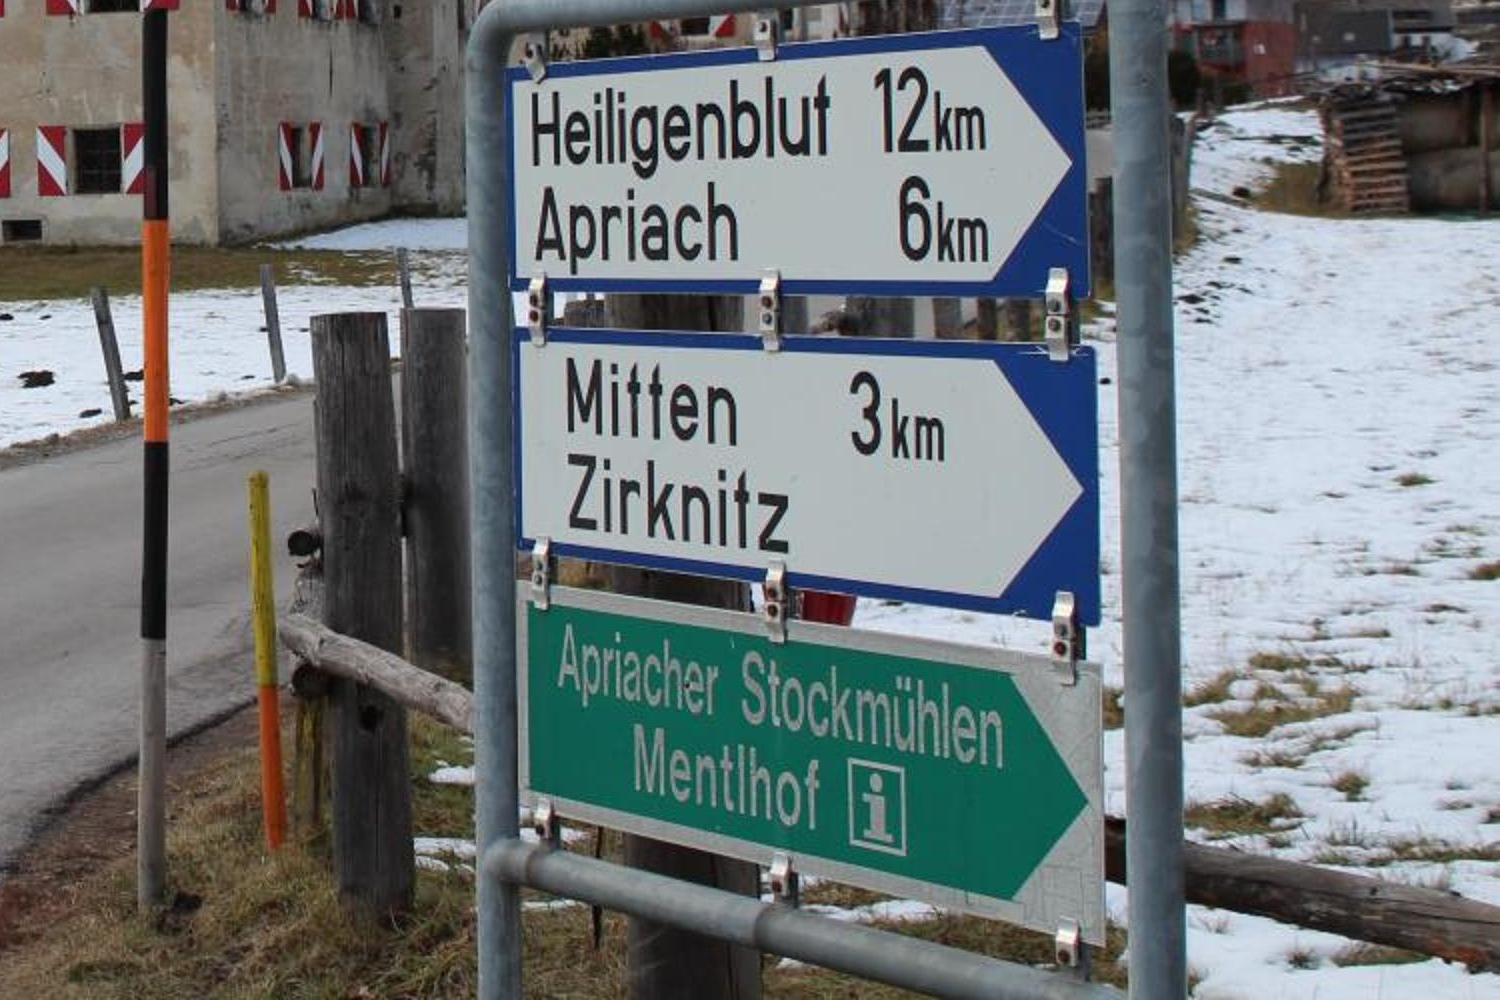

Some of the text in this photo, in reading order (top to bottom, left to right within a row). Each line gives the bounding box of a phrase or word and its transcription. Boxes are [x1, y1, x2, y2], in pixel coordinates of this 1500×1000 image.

[531, 74, 831, 180] Heiligenblut
[535, 181, 739, 276] Apriach
[566, 357, 737, 447] Mitten
[567, 453, 789, 555] Zirknitz
[557, 624, 1004, 768] Apriacher Stockmühlen
[633, 724, 820, 829] Mentlhof
